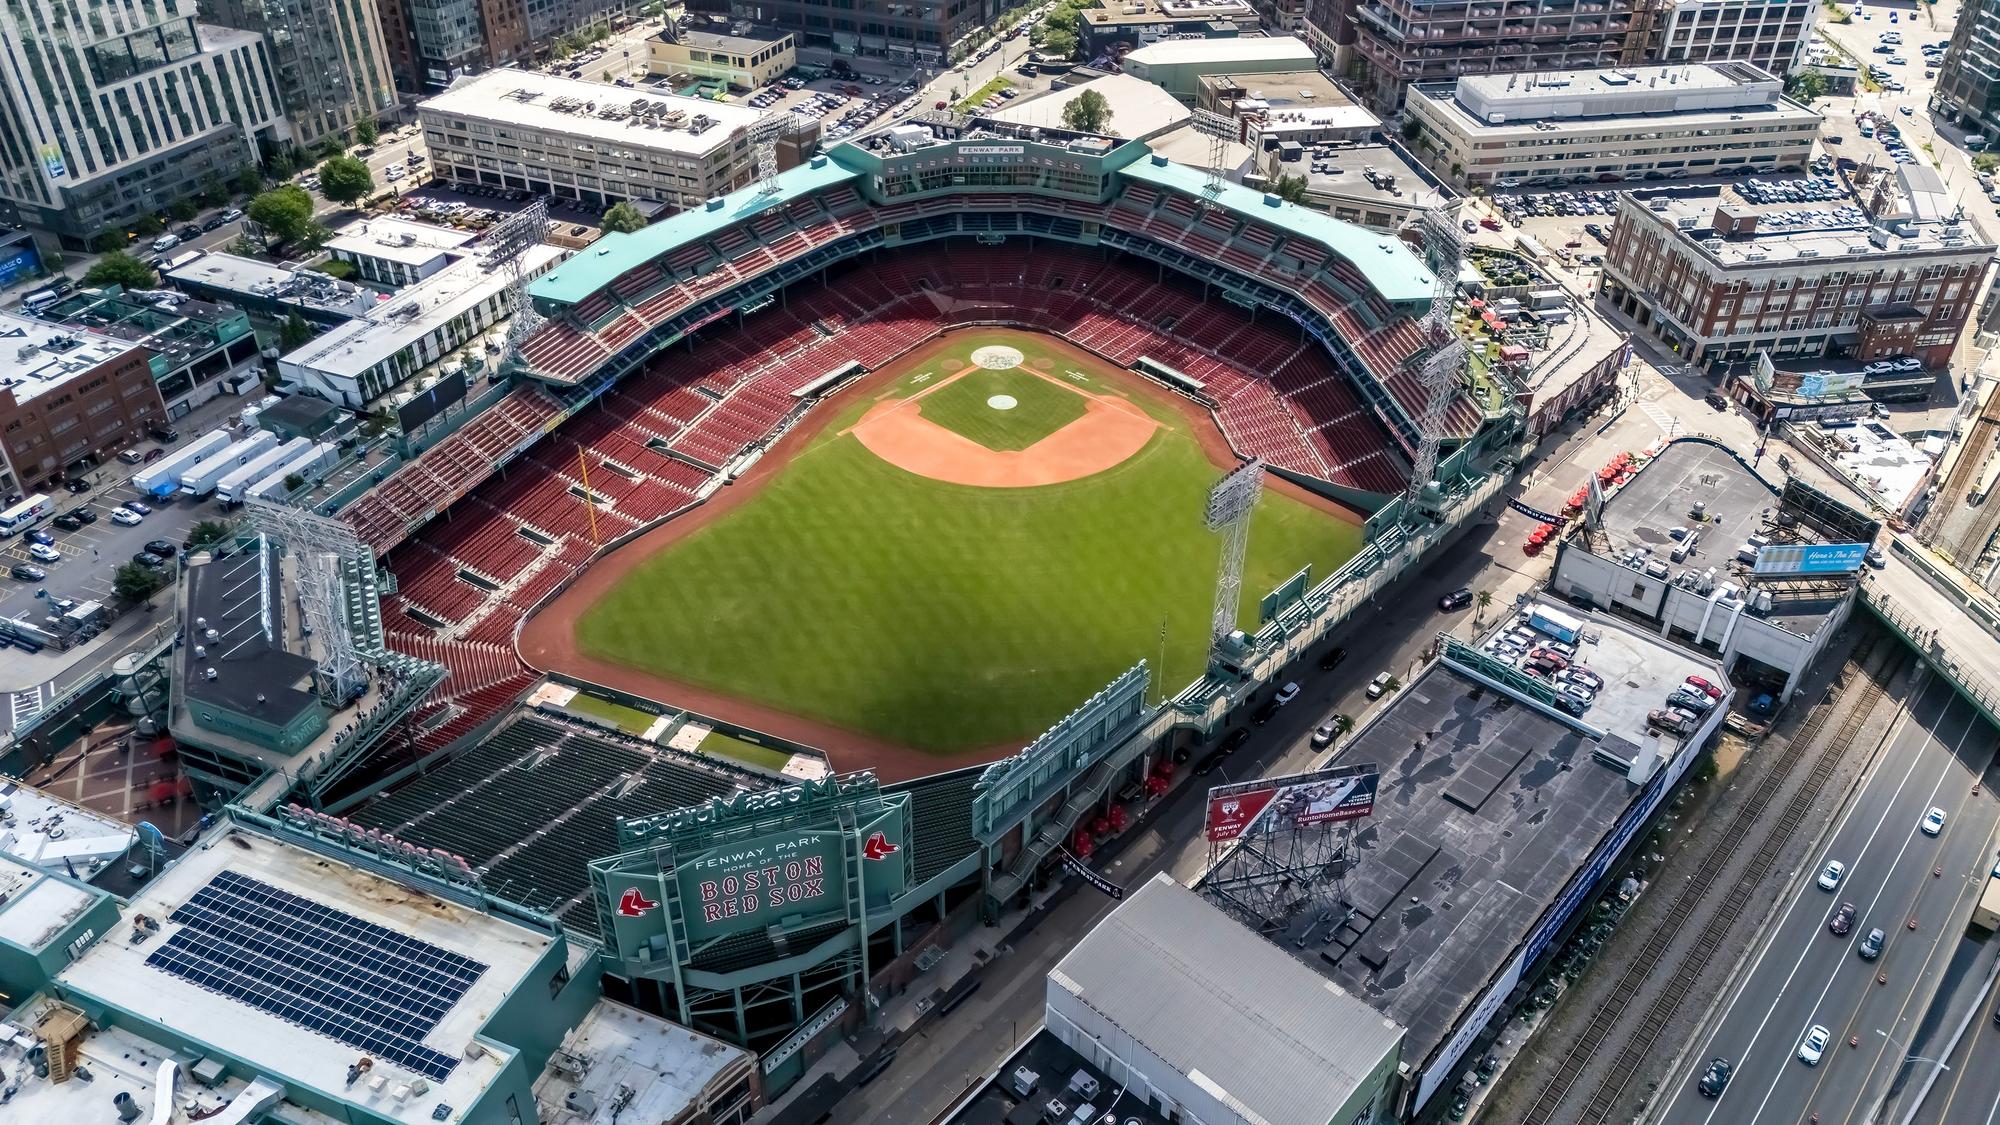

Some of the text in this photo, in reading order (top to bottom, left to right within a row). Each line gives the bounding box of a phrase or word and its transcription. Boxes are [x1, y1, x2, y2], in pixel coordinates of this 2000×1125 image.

[17, 504, 44, 522] FedEx
[1516, 504, 1556, 522] FENWAY PARK
[1214, 823, 1242, 832] FENWAY
[1297, 807, 1370, 823] RuntoHomeBase.org
[695, 834, 821, 871] FENWAY PARK
[723, 851, 799, 874] HOME OF THE
[700, 855, 825, 902] BOSTON
[1068, 860, 1093, 882] FENWAY
[1094, 879, 1112, 893] PARK
[703, 877, 825, 923] RED SOX
[765, 1004, 844, 1069] FENWAY PARK
